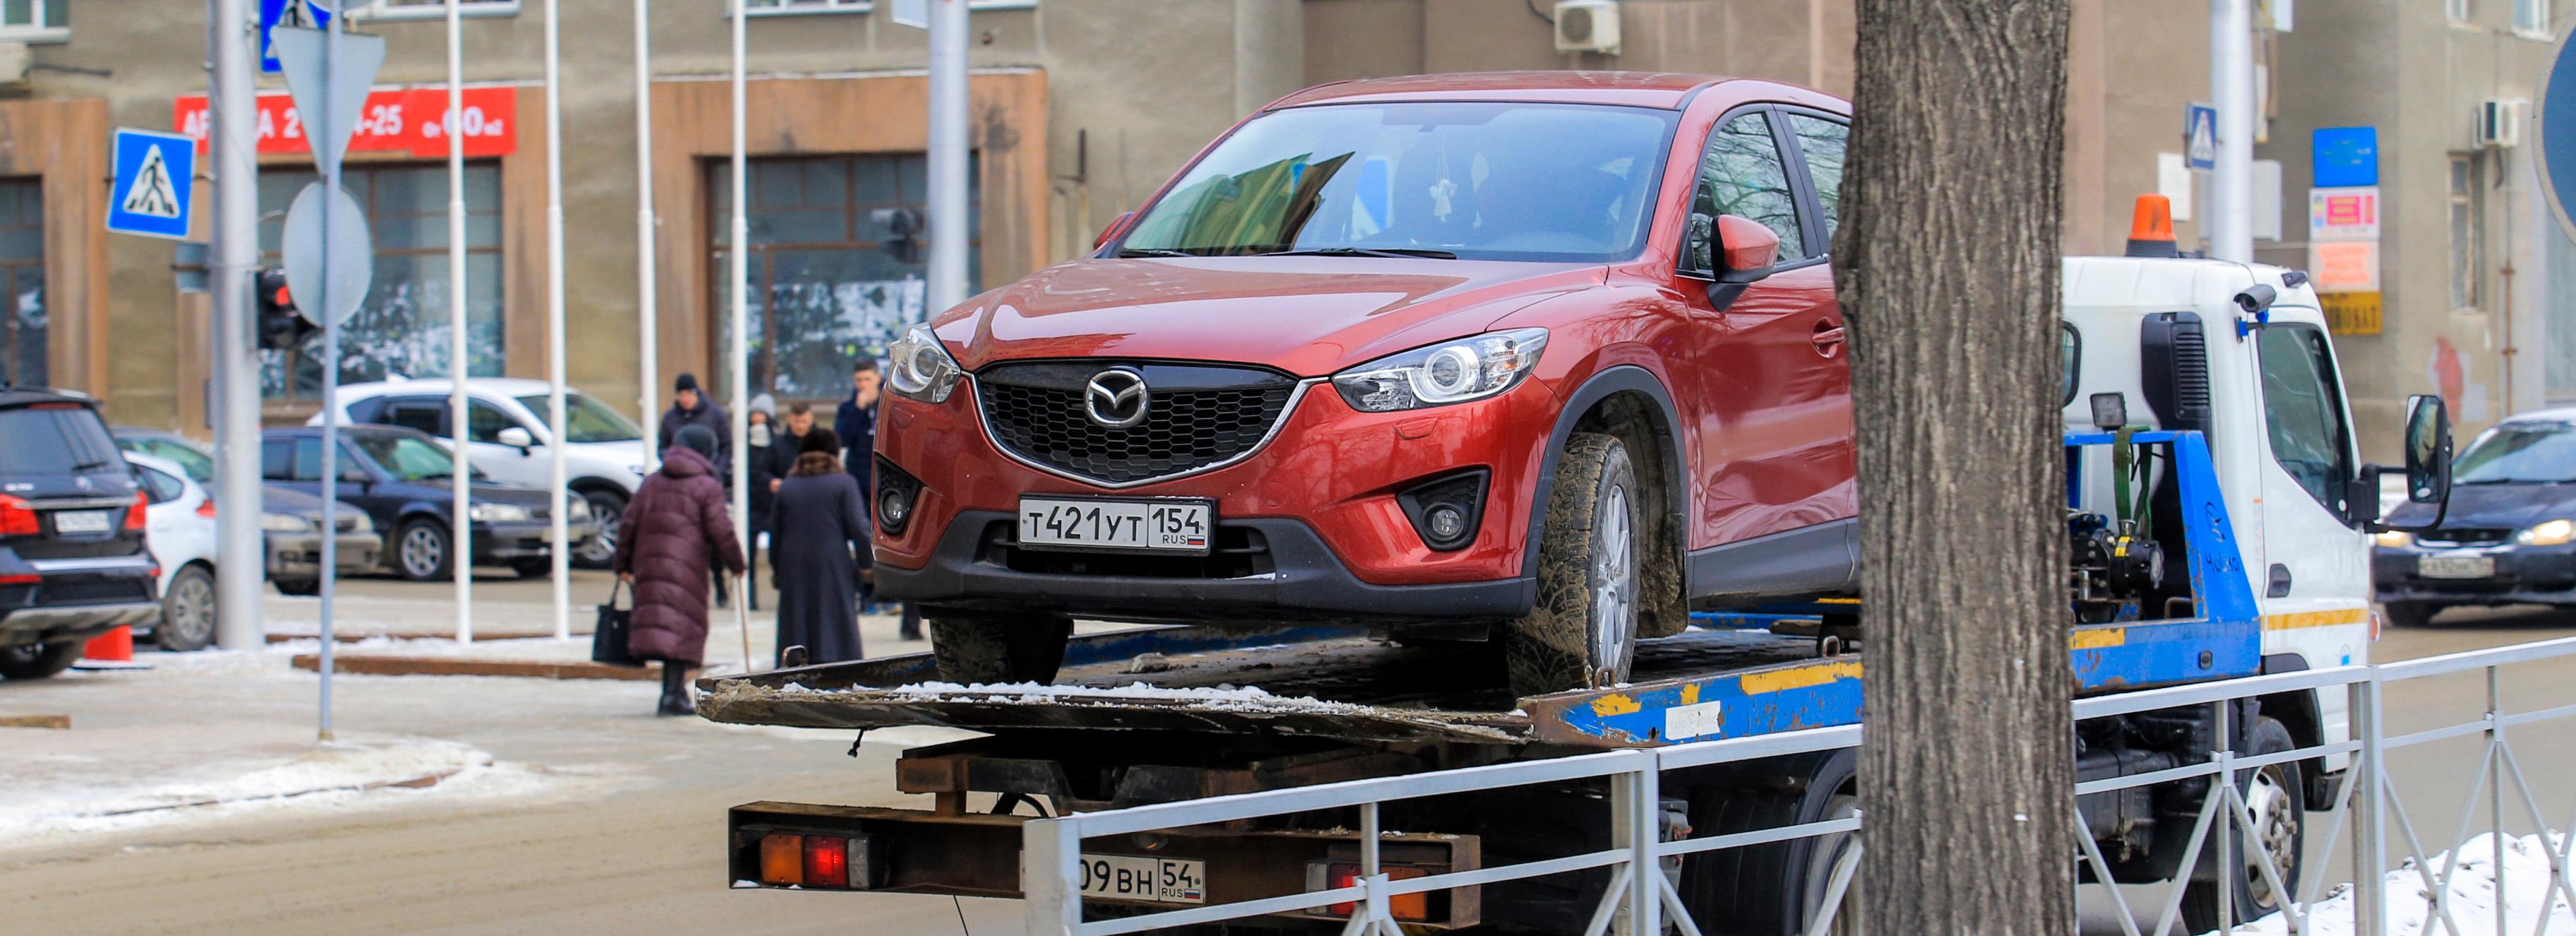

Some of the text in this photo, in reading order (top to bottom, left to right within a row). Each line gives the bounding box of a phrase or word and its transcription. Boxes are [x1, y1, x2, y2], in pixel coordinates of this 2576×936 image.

[1029, 506, 1200, 542] Т421УТ 154
[1162, 534, 1186, 545] RUS
[1080, 859, 1192, 895] 09ВН 54
[1162, 887, 1183, 898] RUS
